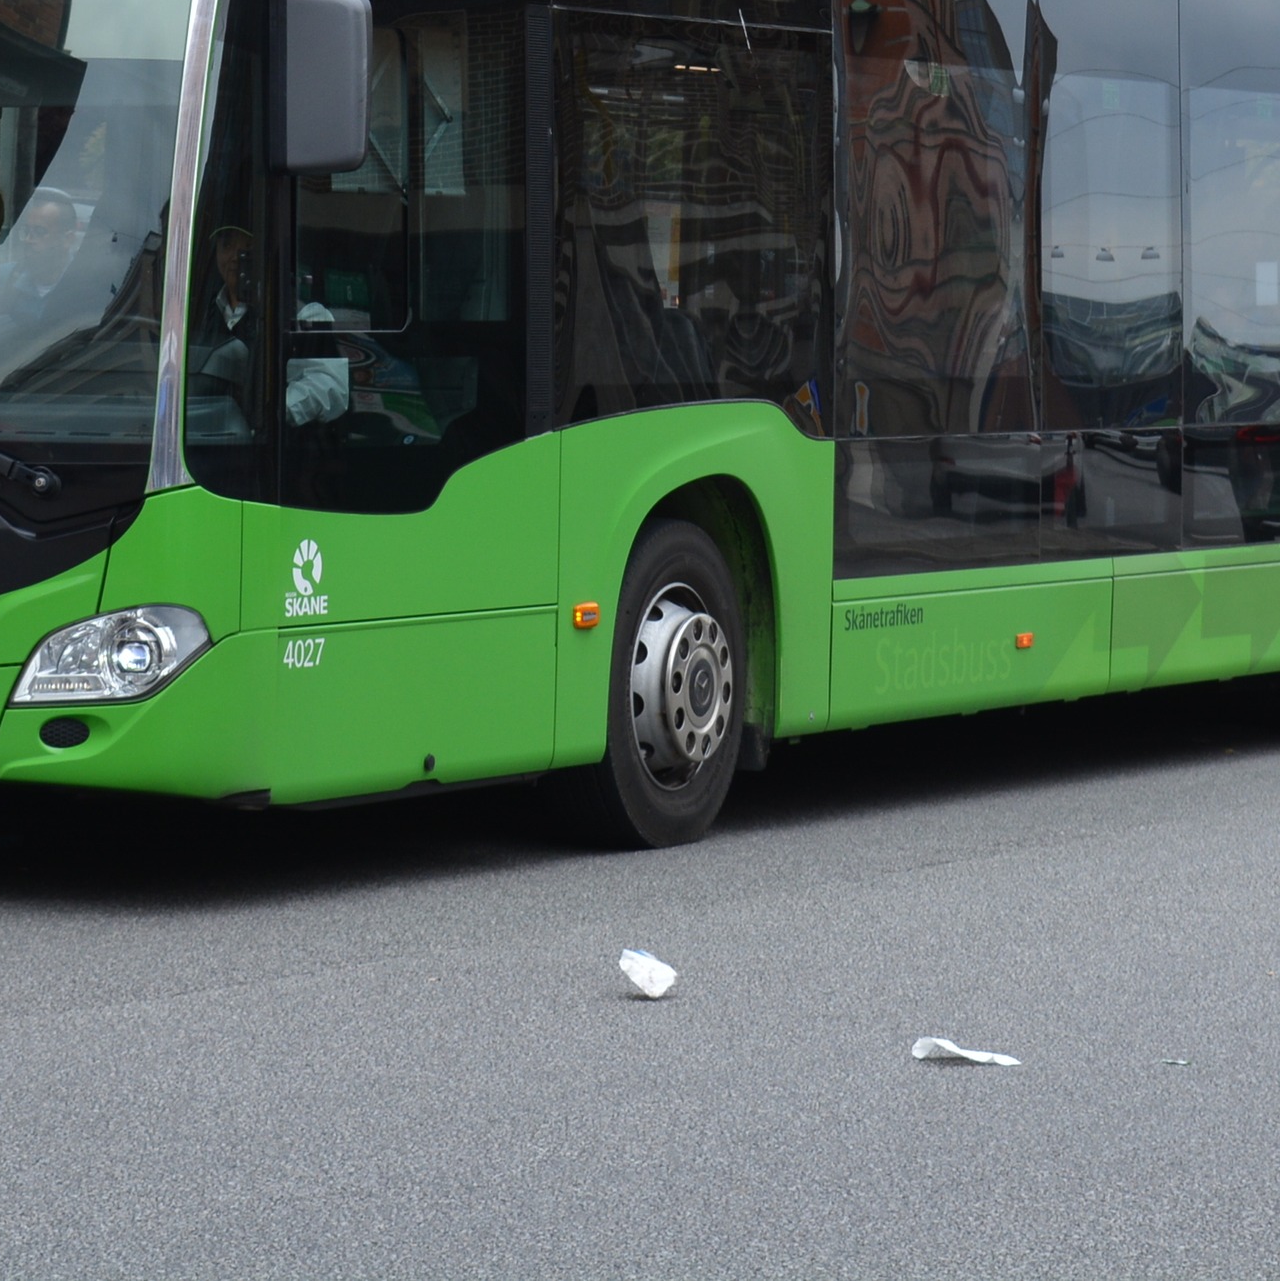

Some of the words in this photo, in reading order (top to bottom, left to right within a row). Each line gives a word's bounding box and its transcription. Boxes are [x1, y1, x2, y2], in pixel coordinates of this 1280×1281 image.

[844, 603, 925, 632] Skånetrafiken
[283, 637, 326, 669] 4027
[874, 627, 1012, 695] Stadsbuss
